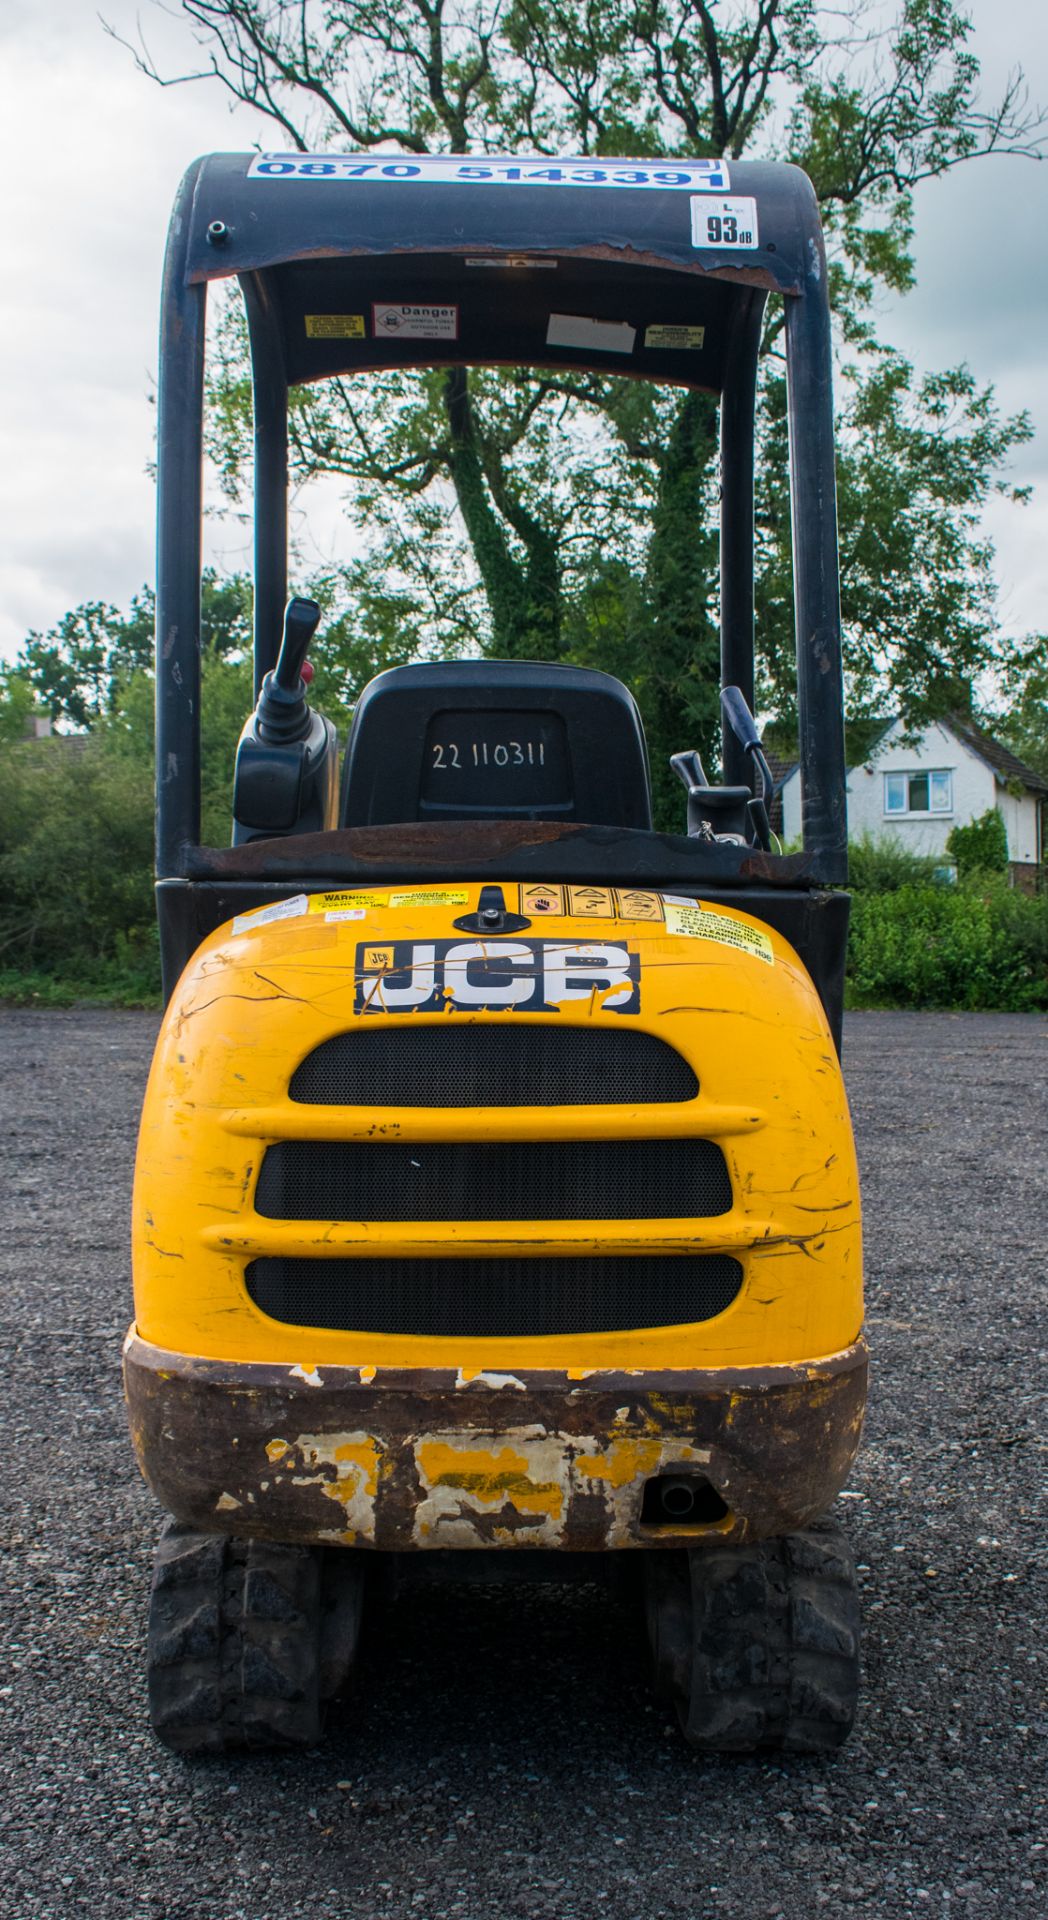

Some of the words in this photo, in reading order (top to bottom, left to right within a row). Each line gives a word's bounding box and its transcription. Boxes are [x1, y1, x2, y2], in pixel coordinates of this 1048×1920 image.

[257, 162, 421, 177] 0870
[456, 166, 723, 187] 5143391
[402, 306, 456, 318] Danger
[433, 743, 462, 768] 22
[472, 742, 545, 767] 110311
[682, 908, 718, 919] PLEASE
[363, 943, 634, 1006] JCB
